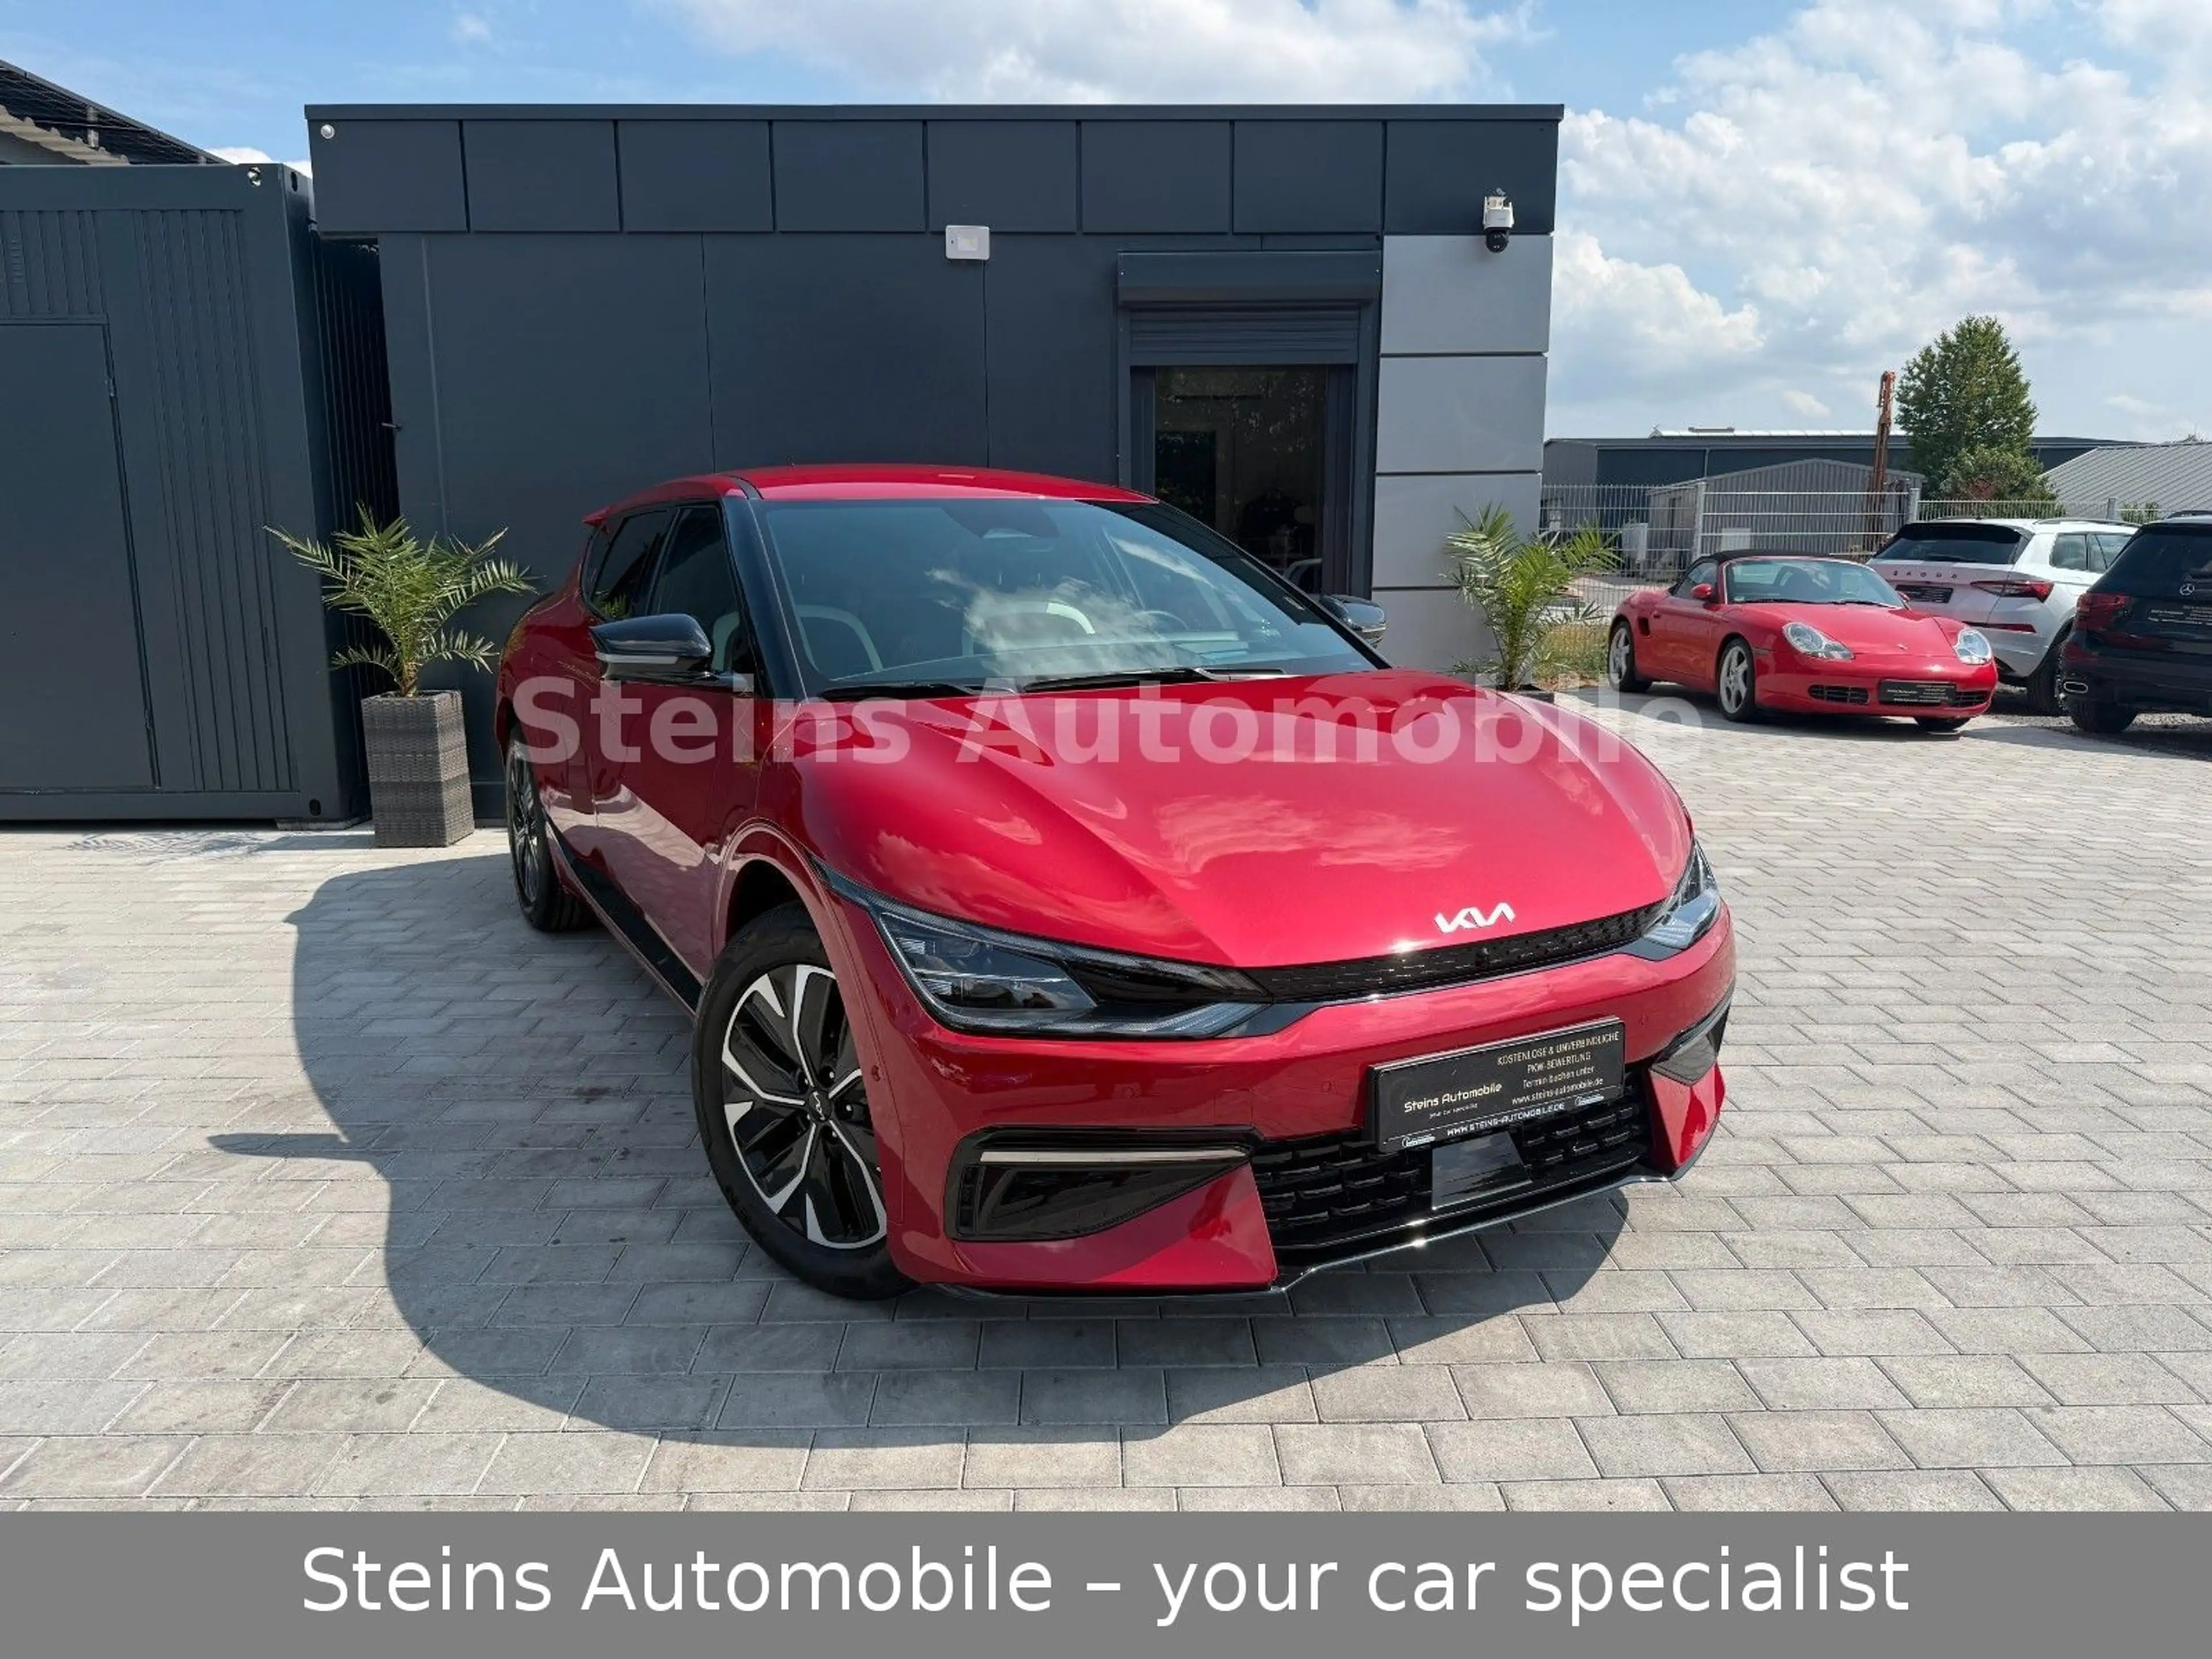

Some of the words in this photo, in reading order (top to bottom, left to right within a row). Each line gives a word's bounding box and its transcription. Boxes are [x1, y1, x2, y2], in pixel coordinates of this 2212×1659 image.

[1498, 1047, 1547, 1066] KOSTENLOSE
[1404, 1097, 1439, 1113] Steins
[1442, 1082, 1503, 1105] Automobile
